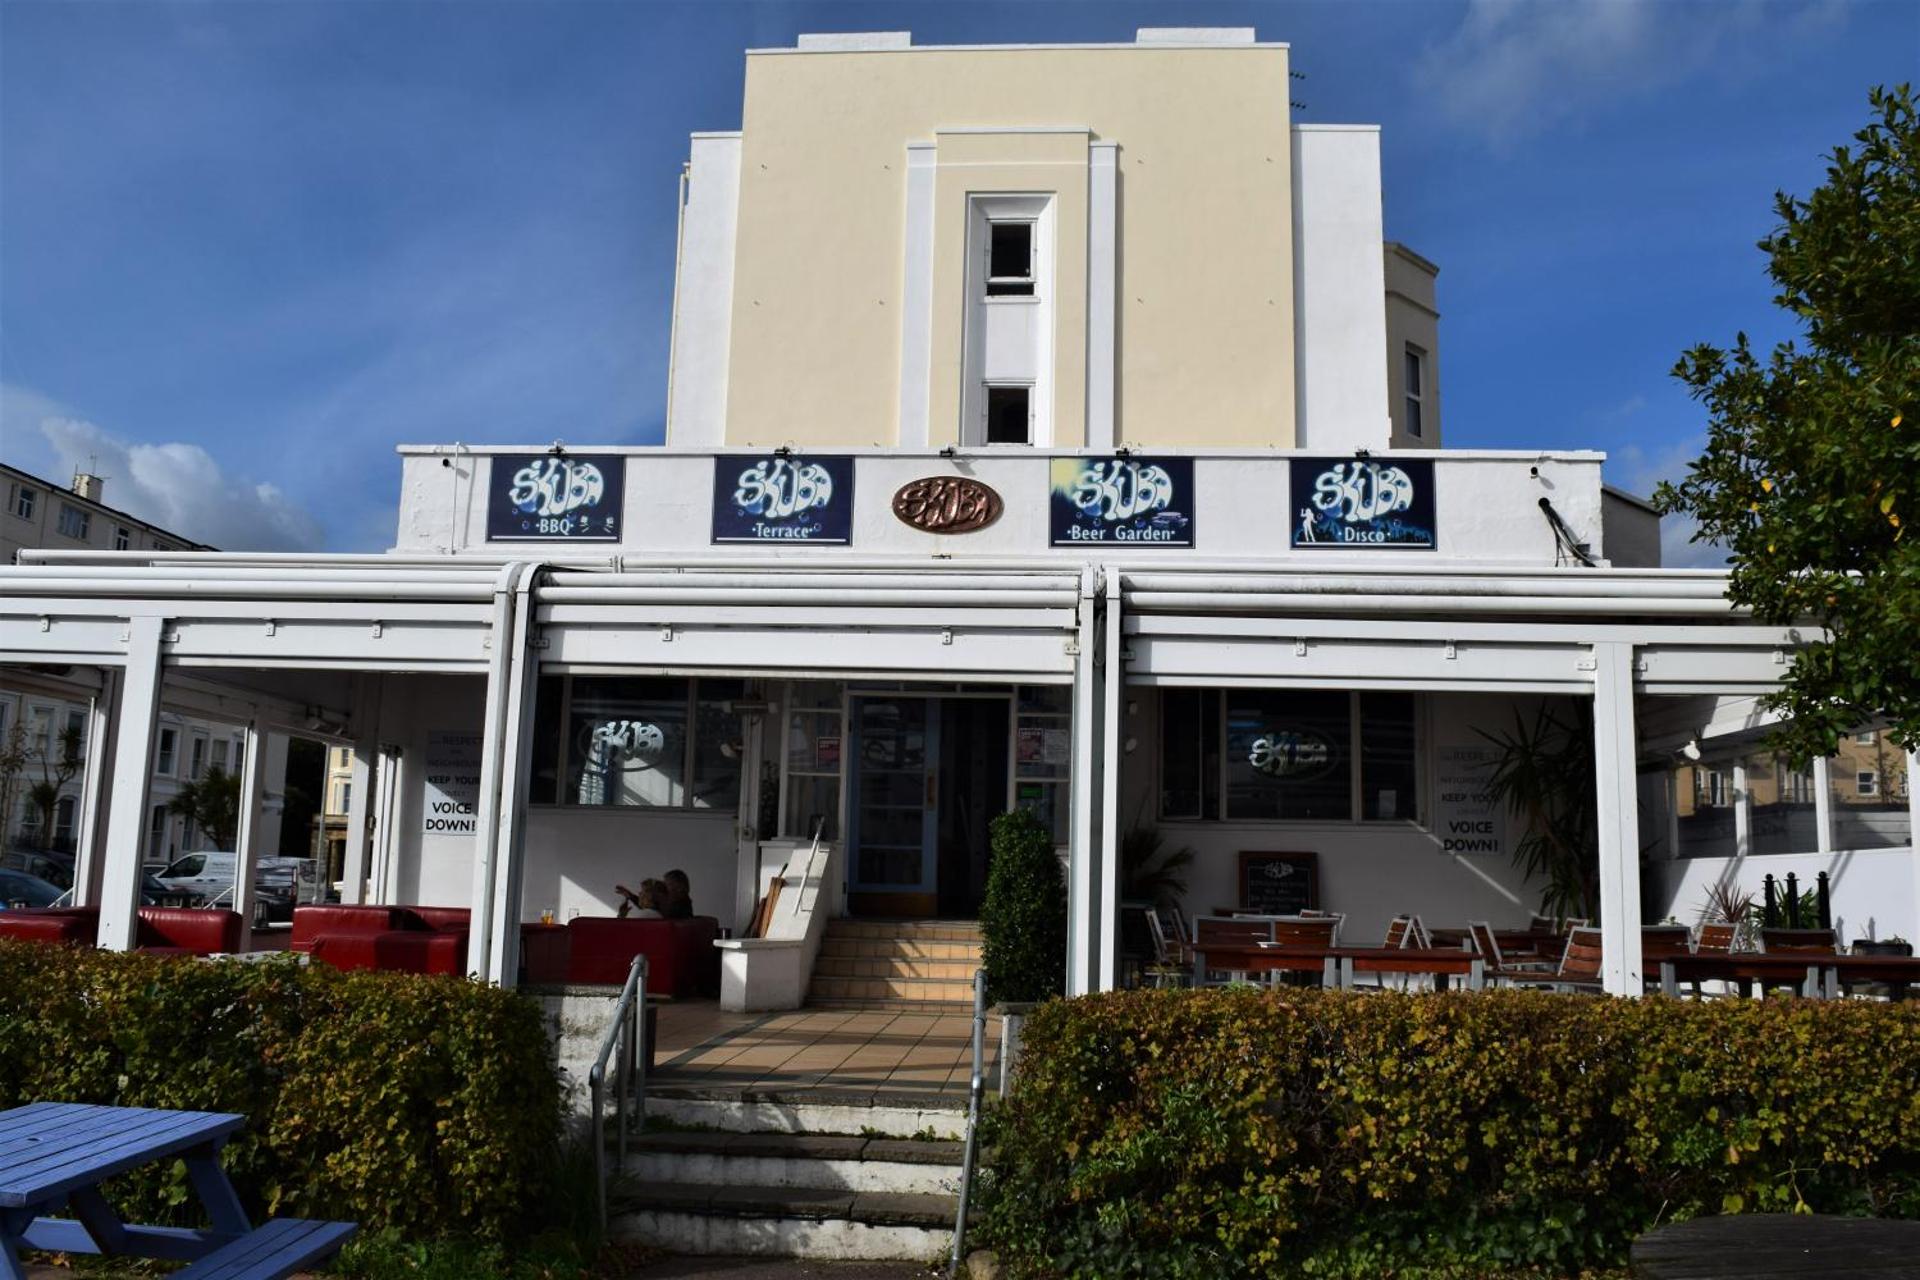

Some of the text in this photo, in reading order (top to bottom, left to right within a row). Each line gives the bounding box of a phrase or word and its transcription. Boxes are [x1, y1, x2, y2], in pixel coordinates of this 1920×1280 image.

[508, 458, 604, 517] SKUBA
[735, 458, 833, 518] SKUBA
[1074, 460, 1174, 521] SKUBA
[1313, 460, 1414, 521] SKUBA
[539, 518, 571, 535] BBQ
[757, 522, 810, 538] Terrace
[1071, 525, 1171, 541] Beer Garden
[1344, 526, 1385, 543] Disco
[428, 775, 451, 785] KEEP
[432, 802, 472, 814] VOICE
[426, 818, 476, 832] DOWN!
[1449, 820, 1493, 834] VOICE
[1444, 839, 1498, 852] DOWN!
